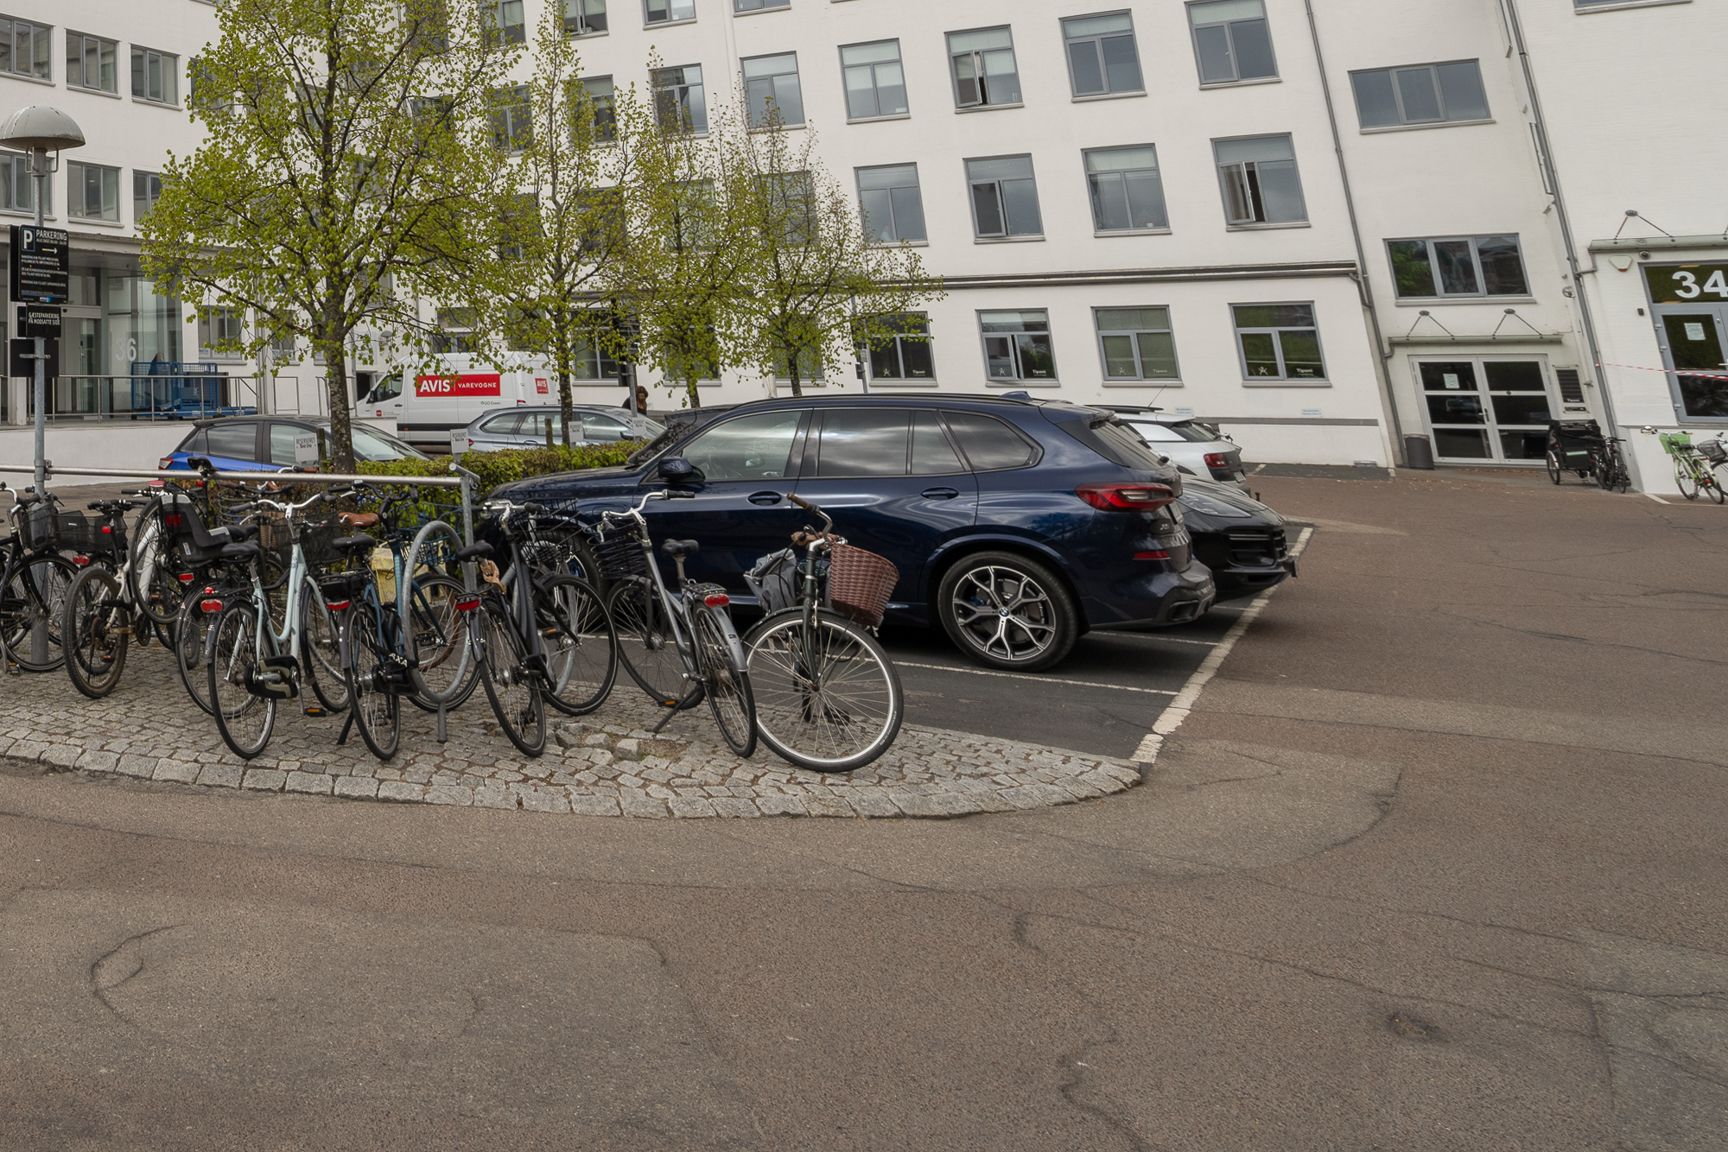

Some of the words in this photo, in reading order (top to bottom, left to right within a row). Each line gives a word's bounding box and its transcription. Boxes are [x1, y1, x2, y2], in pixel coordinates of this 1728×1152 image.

[23, 229, 33, 249] P
[35, 230, 68, 241] PARKERING
[1672, 269, 1728, 299] 34
[420, 379, 451, 392] AVIS
[389, 652, 408, 668] AXA
